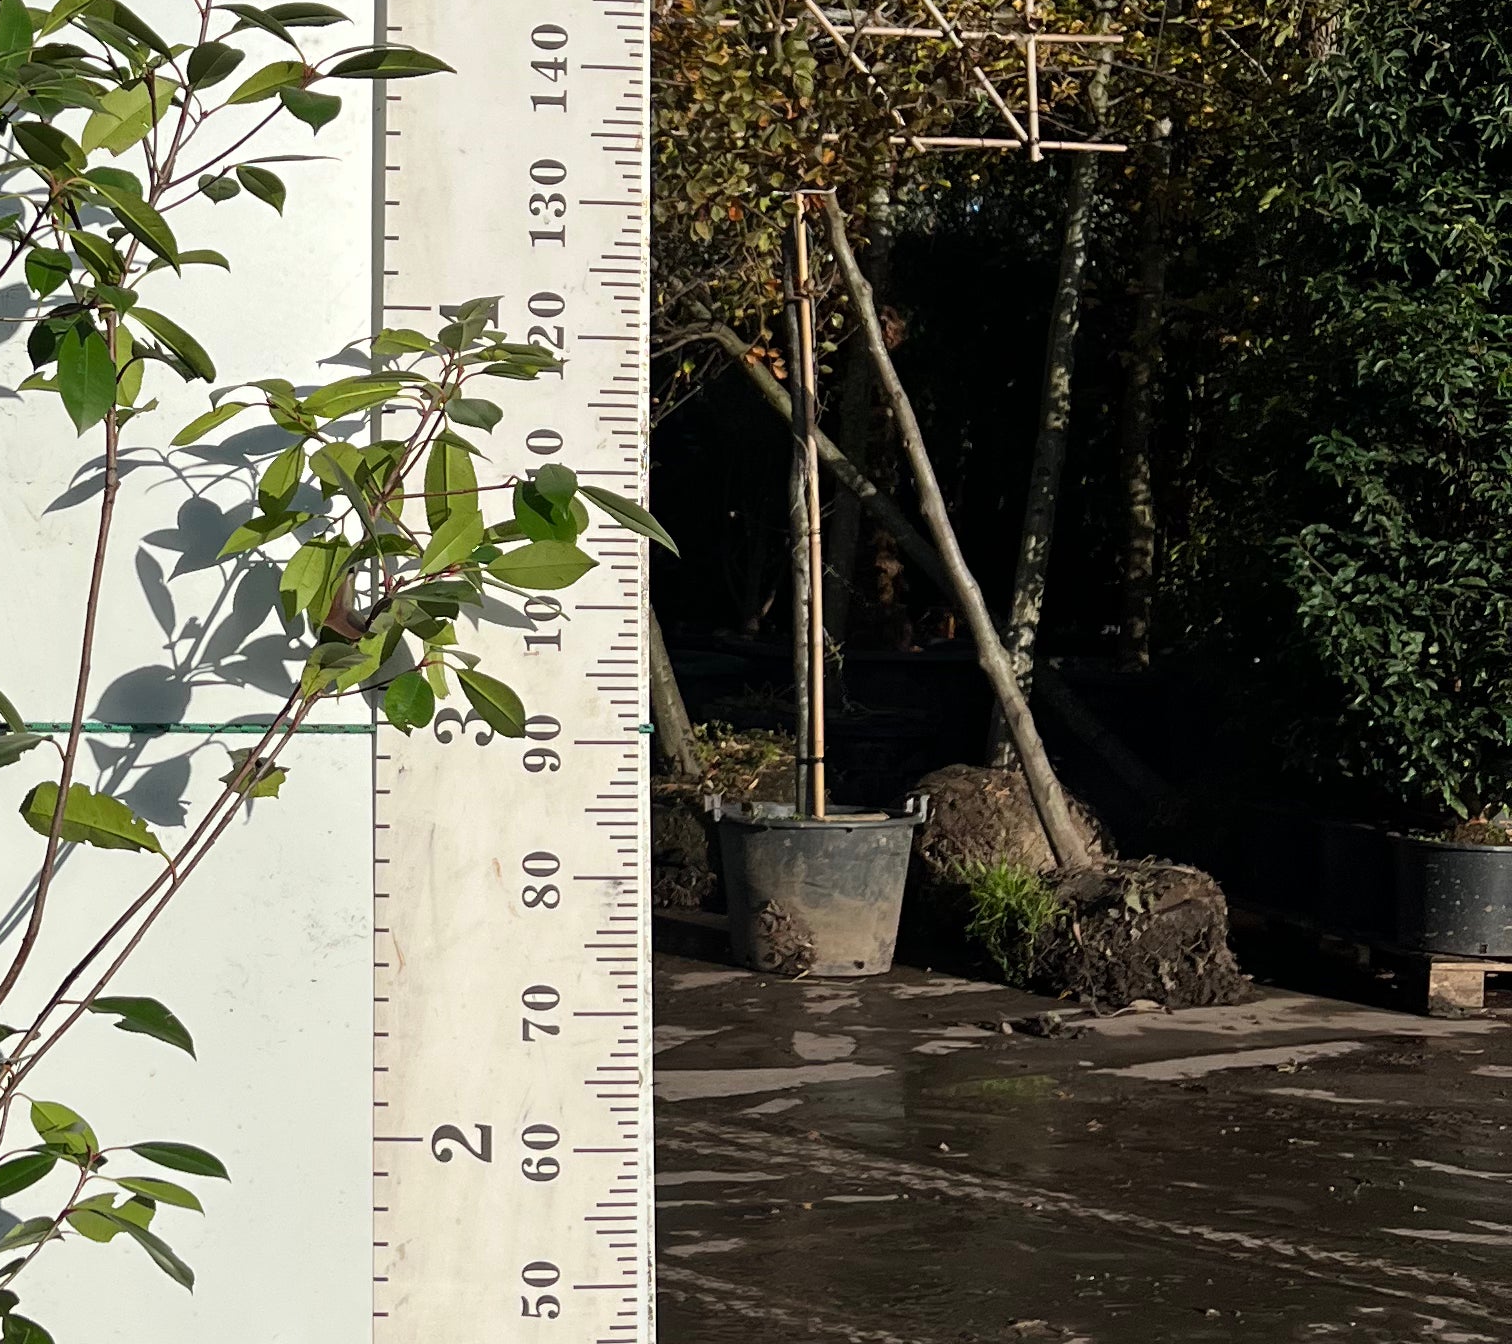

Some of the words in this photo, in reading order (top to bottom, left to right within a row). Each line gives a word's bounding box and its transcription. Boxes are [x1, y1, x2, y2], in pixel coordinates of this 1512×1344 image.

[530, 24, 569, 112] 140
[529, 159, 567, 247] 130
[524, 595, 562, 652] 10
[434, 707, 495, 746] 3
[523, 715, 561, 773] 90
[522, 852, 561, 909] 80
[522, 985, 560, 1042] 70
[431, 1124, 492, 1163] 2
[522, 1124, 560, 1182] 60
[522, 1262, 560, 1320] 50
